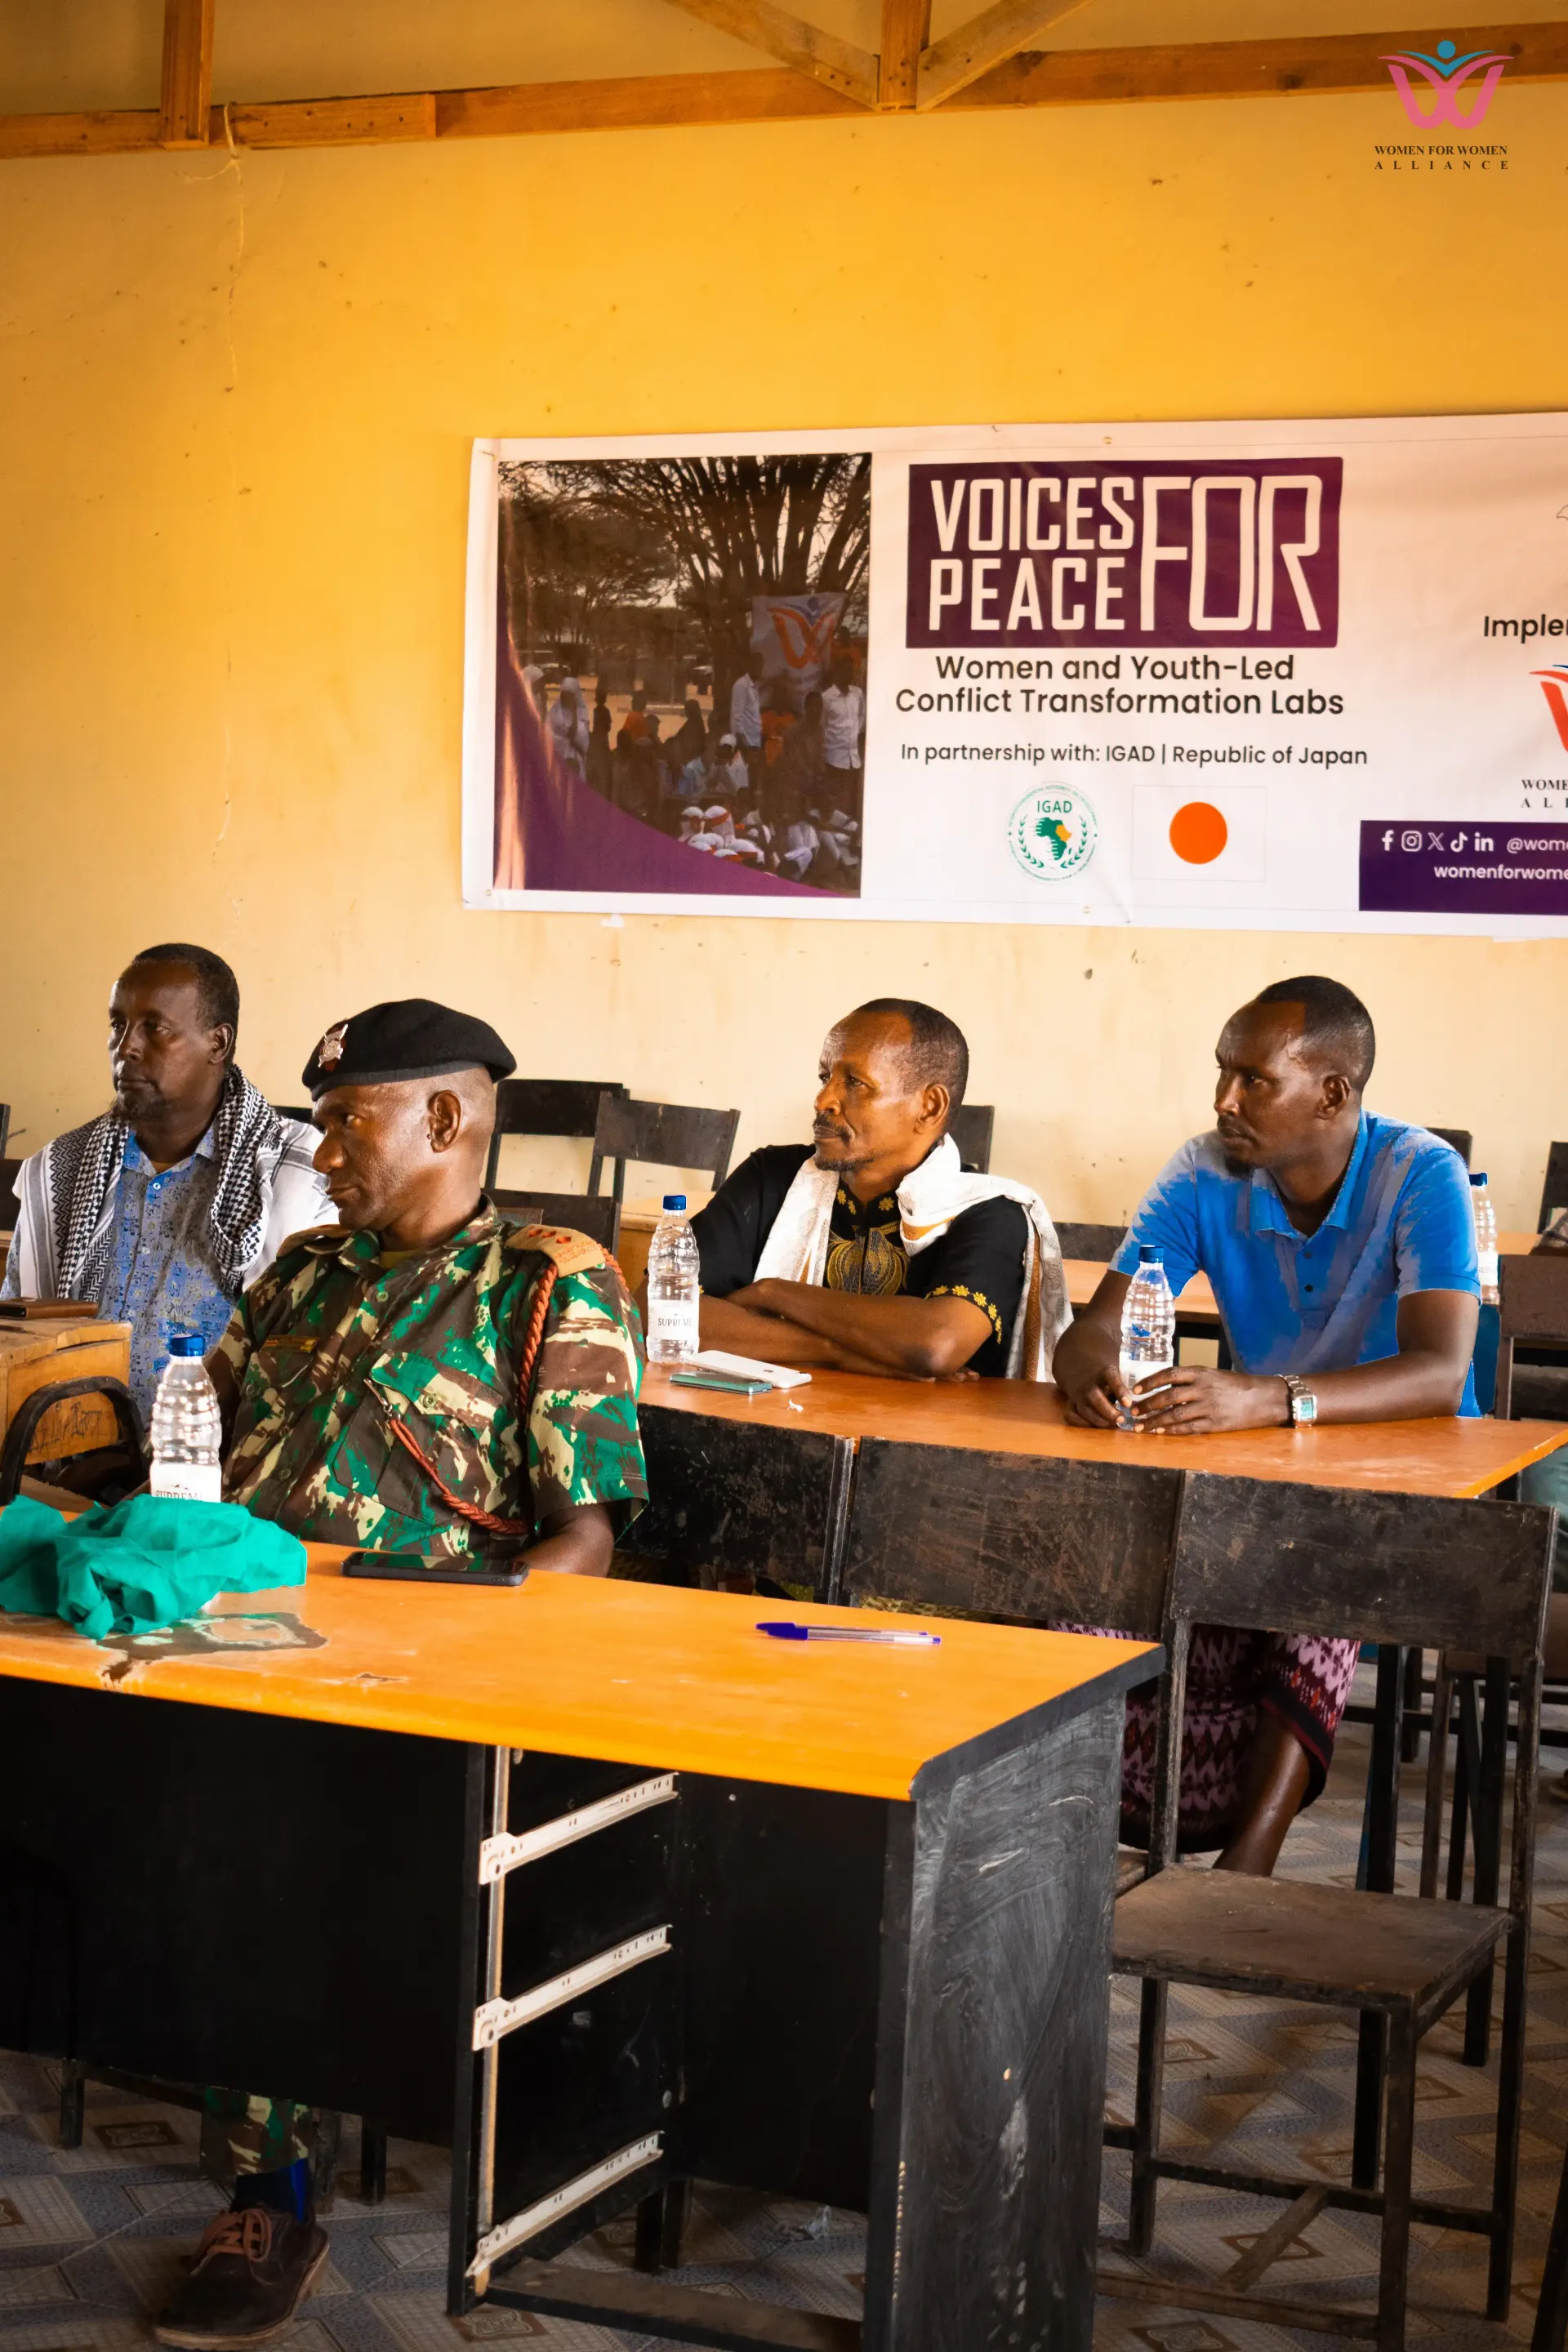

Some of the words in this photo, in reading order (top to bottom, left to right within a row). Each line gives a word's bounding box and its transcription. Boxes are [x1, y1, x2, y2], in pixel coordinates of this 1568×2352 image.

[930, 477, 1134, 552] VOICES
[1140, 475, 1323, 631] FOR
[929, 557, 1125, 630] PEACE
[1483, 613, 1568, 644] Imple
[935, 656, 1053, 679] Women
[1062, 654, 1121, 679] and
[1130, 654, 1294, 680] Youth-Led
[896, 686, 1012, 713] Conflict
[1019, 687, 1262, 715] Transformation
[1272, 688, 1344, 715] Labs
[901, 743, 919, 760] In
[924, 742, 1045, 767] partnership
[1050, 743, 1101, 762] with:
[1105, 745, 1156, 763] IGAD
[1173, 745, 1266, 768] Republic
[1272, 744, 1293, 764] of
[1298, 747, 1369, 770] Japan
[1036, 800, 1073, 813] IGAD
[1506, 837, 1568, 854] @wom
